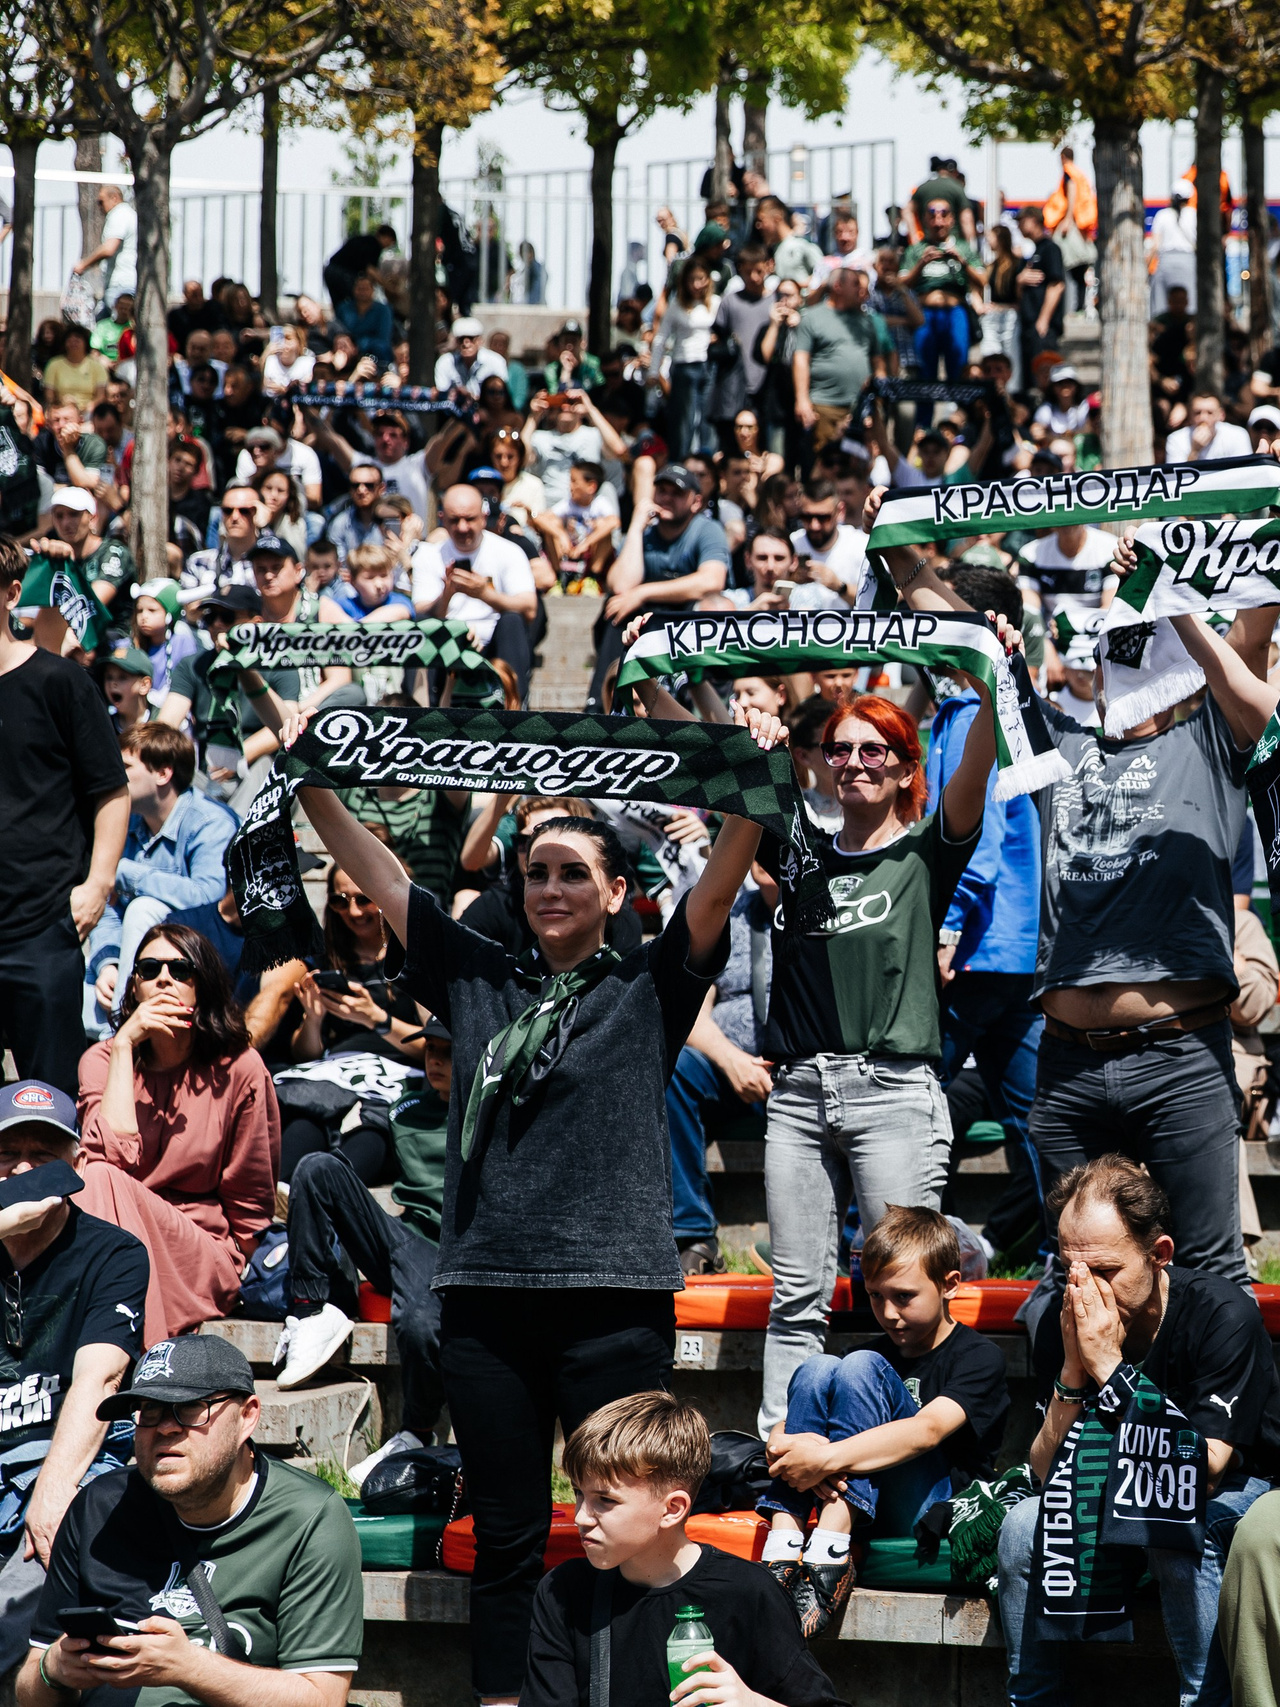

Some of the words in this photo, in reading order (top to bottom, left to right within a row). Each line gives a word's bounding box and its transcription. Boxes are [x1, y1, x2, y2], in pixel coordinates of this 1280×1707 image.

[931, 467, 1202, 525] КРАСНОДАР
[232, 622, 428, 667] Краснодар
[664, 610, 940, 660] КРАСНОДАР
[314, 709, 681, 796] Краснодар
[395, 771, 490, 790] ФУТБОЛЬНЫЙ
[490, 779, 527, 791] КЛУБ
[683, 1341, 700, 1356] 23
[1118, 1422, 1171, 1459] КЛУБ
[1114, 1458, 1198, 1512] 2008
